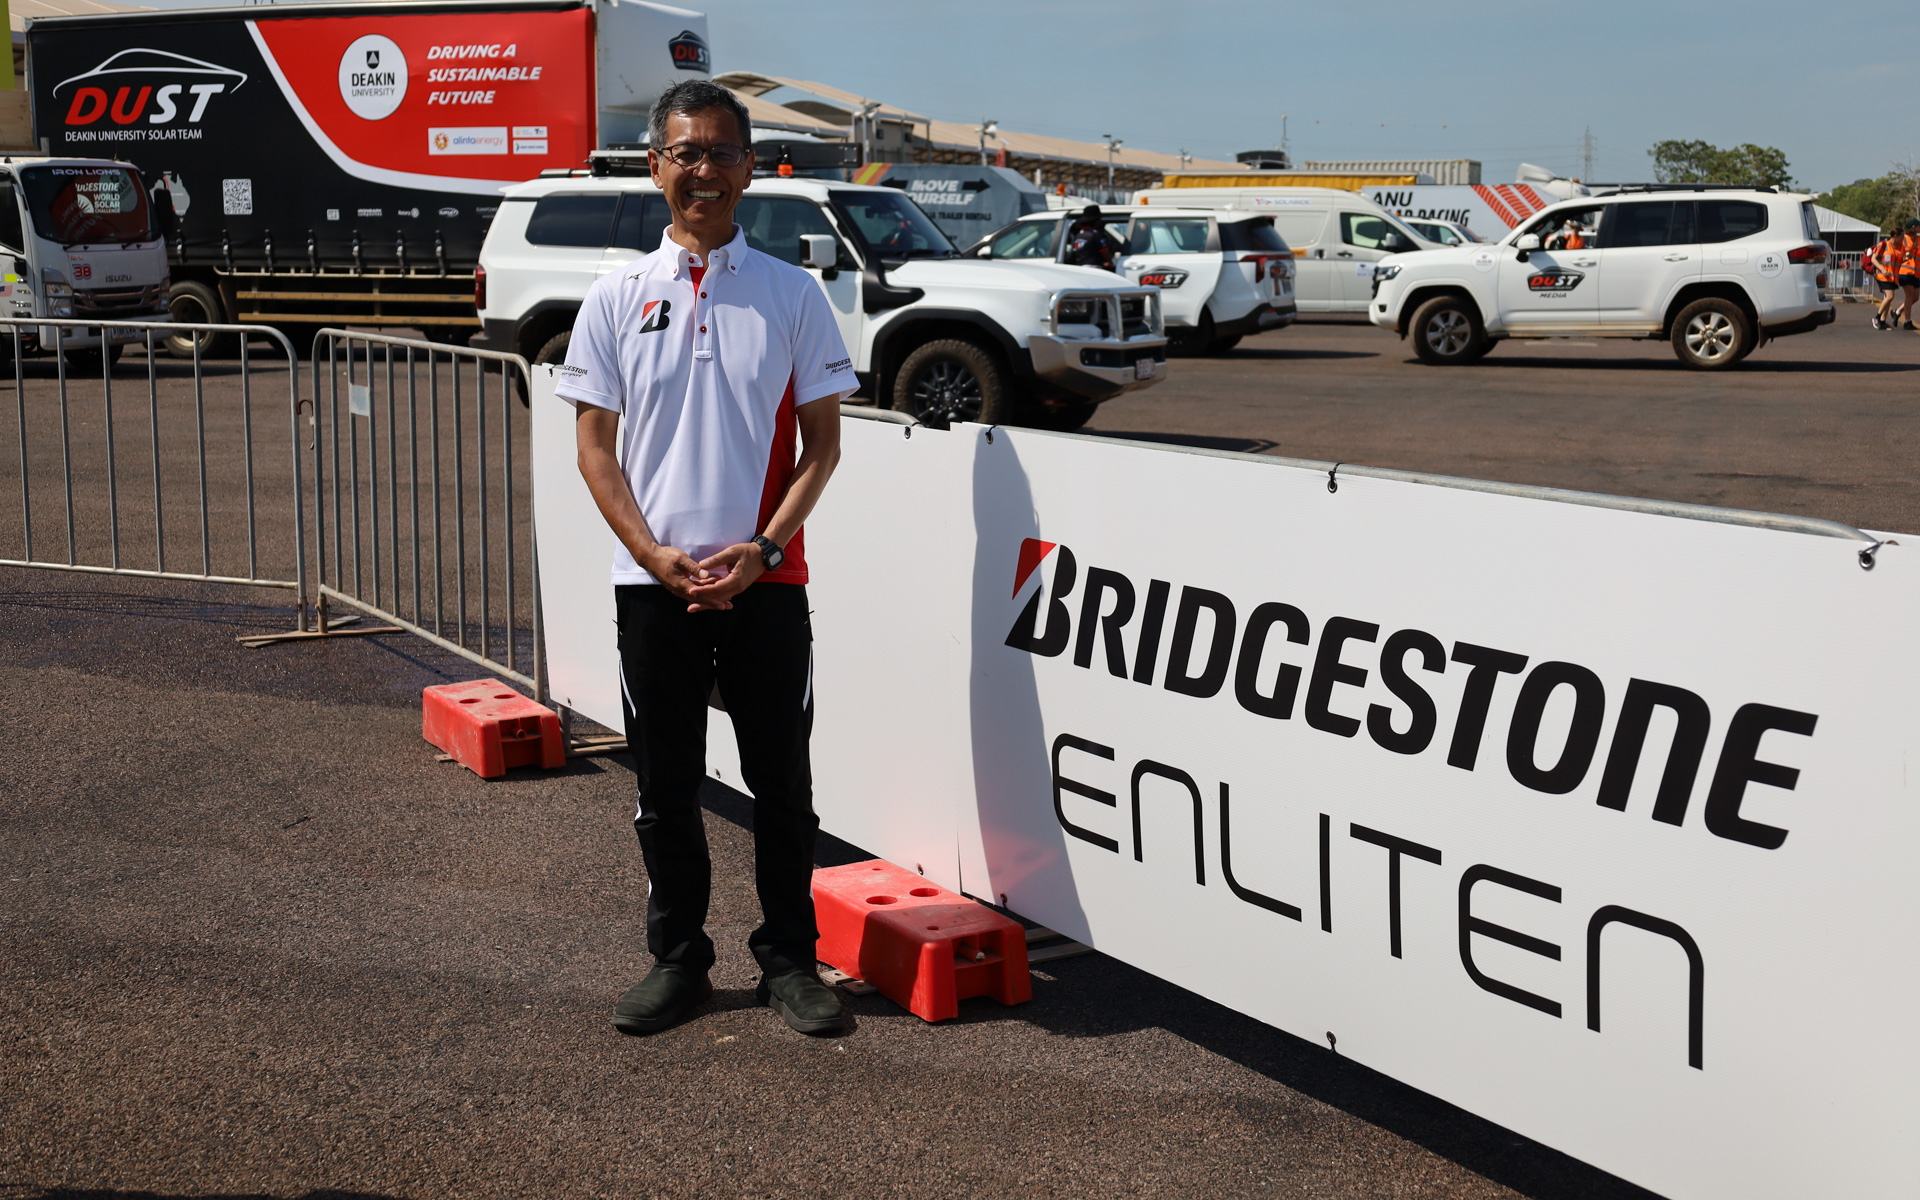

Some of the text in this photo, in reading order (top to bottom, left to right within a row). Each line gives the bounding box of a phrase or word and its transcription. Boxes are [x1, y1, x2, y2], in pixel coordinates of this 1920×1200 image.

[427, 44, 516, 59] DRIVING A
[674, 44, 709, 64] DUST
[351, 72, 395, 86] DEAKIN
[427, 66, 542, 82] SUSTAINABLE
[351, 87, 395, 97] UNIVERSITY
[427, 90, 495, 105] FUTURE
[64, 84, 226, 125] DUST
[65, 129, 203, 142] DEAKIN UNIVERSITY SOLAR TEAM
[452, 136, 504, 147] alintaenergy
[52, 168, 120, 176] IRON LIONS
[911, 179, 959, 192] MOVE
[94, 193, 120, 201] WORLD
[907, 192, 975, 205] OURSELF
[1373, 191, 1413, 207] ANU
[72, 263, 93, 281] 38
[105, 274, 132, 283] ISUZU
[1140, 273, 1184, 286] DUST
[1529, 275, 1579, 287] DUST
[1005, 538, 1819, 850] BRIDGESTONE
[1052, 732, 1705, 1071] ENLITEN
